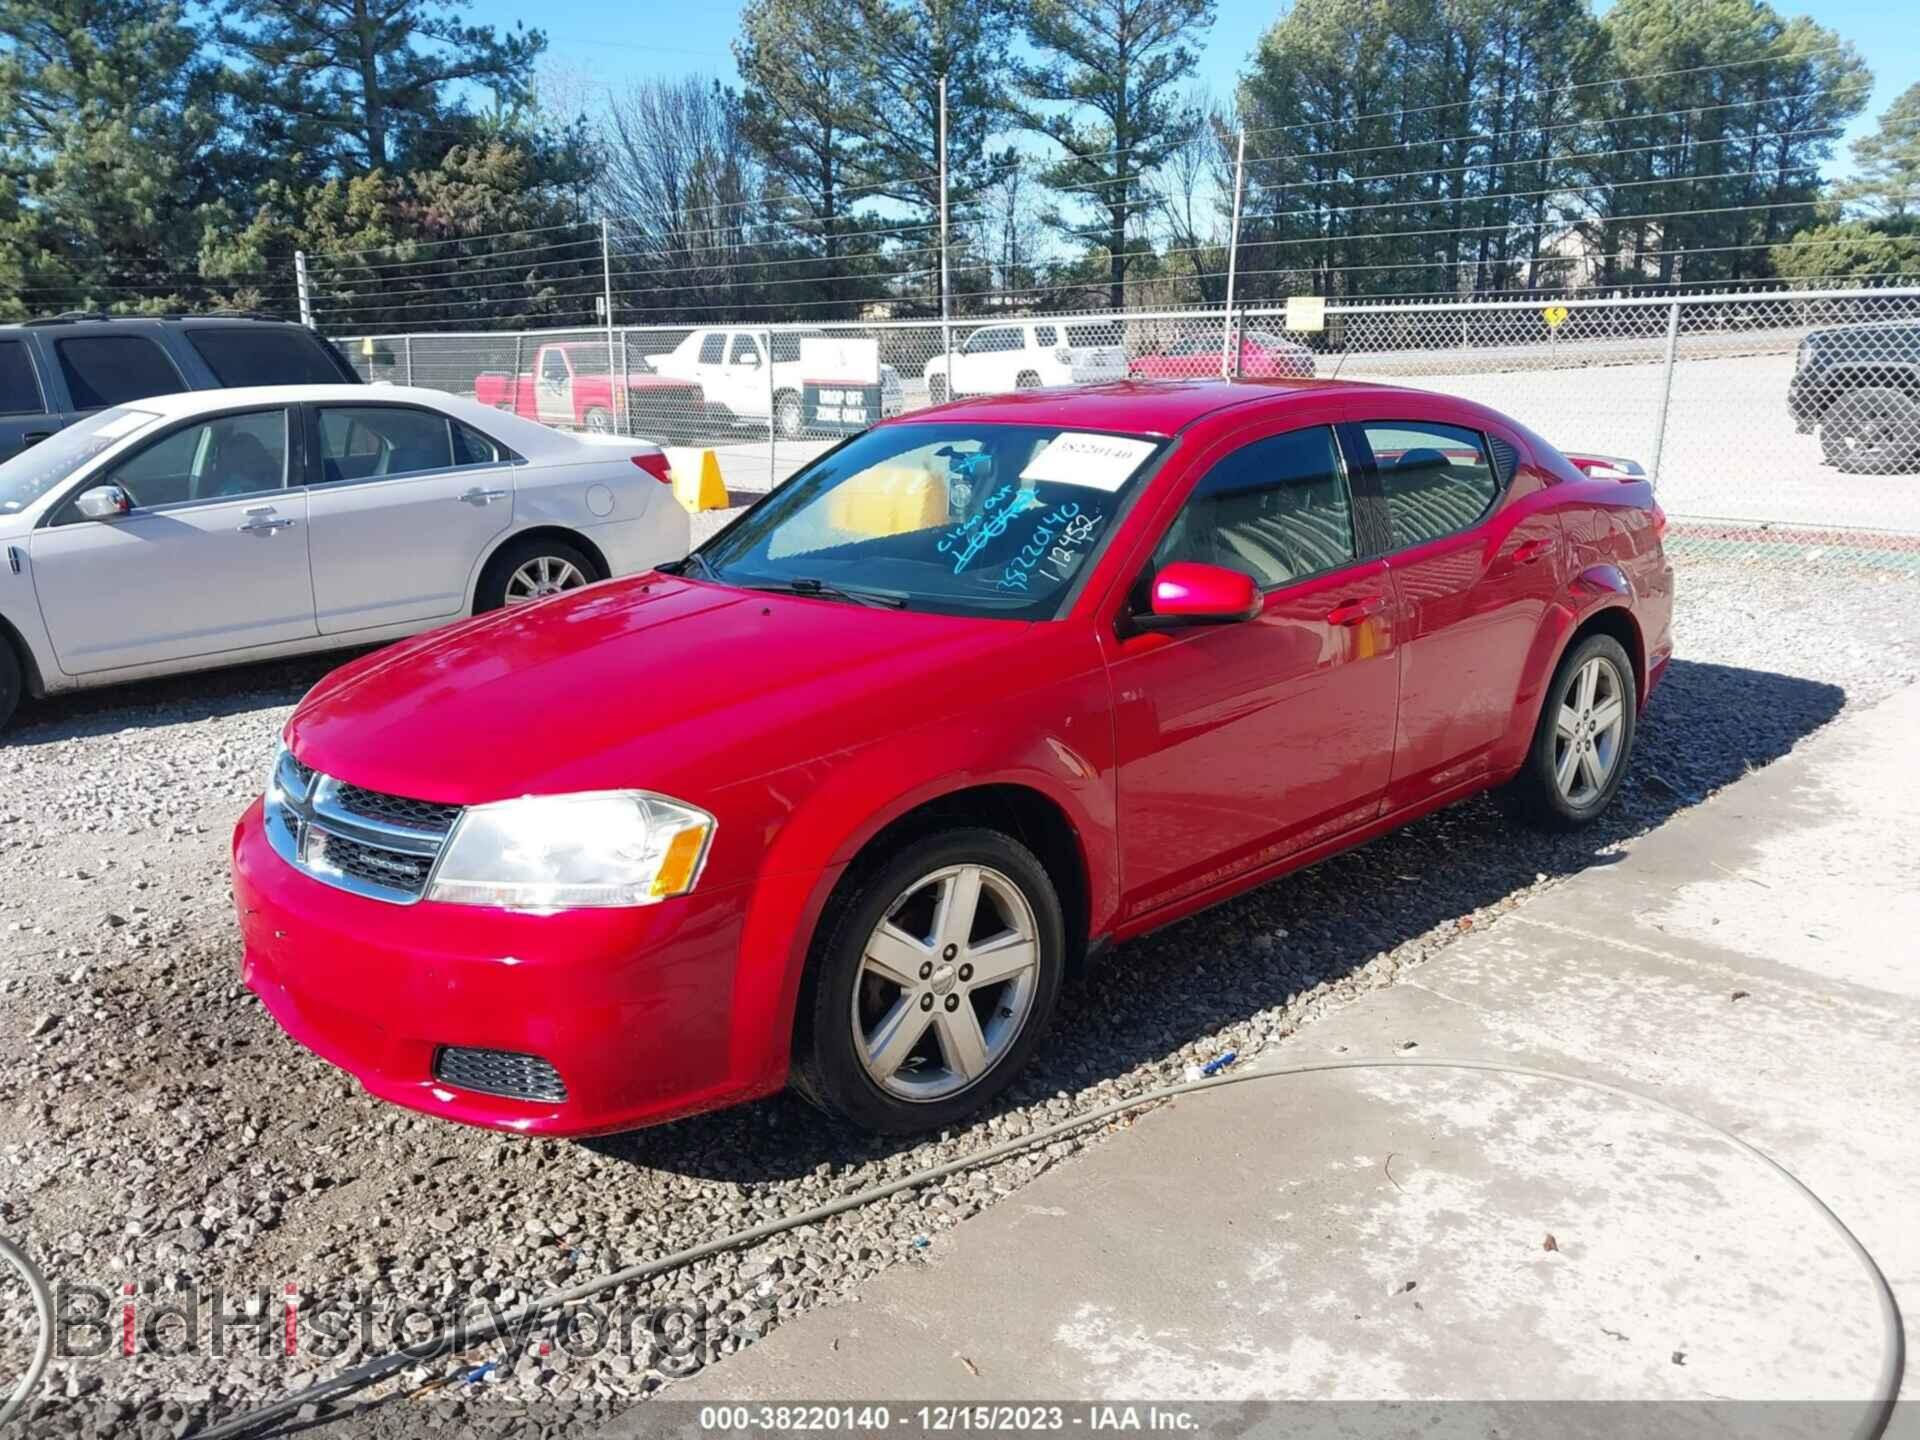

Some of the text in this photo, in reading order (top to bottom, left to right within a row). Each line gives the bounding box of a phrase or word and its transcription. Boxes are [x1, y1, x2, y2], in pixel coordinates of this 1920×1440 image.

[818, 389, 864, 406] DROP OFF
[816, 405, 867, 423] ZONE ONLY
